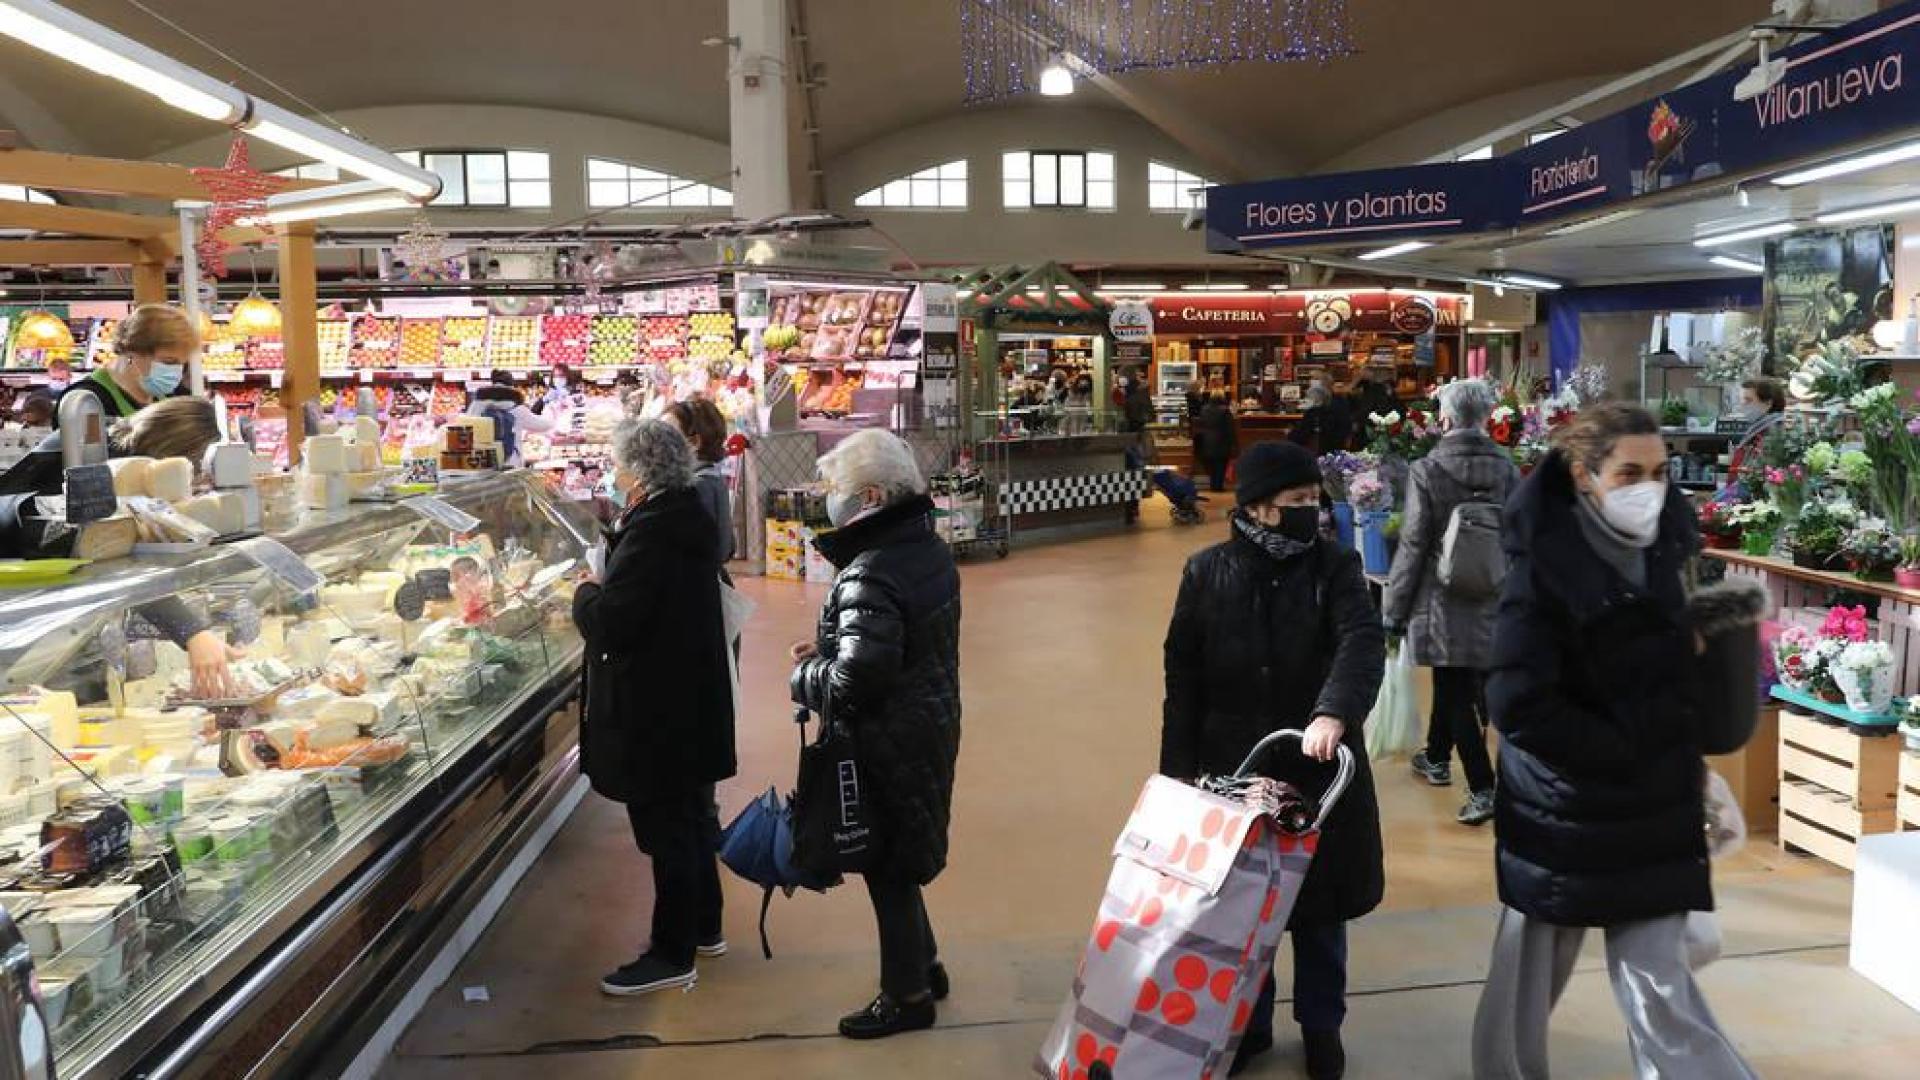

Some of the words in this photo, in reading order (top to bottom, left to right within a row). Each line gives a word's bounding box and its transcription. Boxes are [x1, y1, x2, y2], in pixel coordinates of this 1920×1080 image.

[1754, 53, 1902, 128] Villanueva
[1246, 201, 1317, 228] Flores
[1322, 200, 1339, 226] y
[1344, 188, 1447, 225] plantas
[1181, 306, 1266, 322] CAFETERIA
